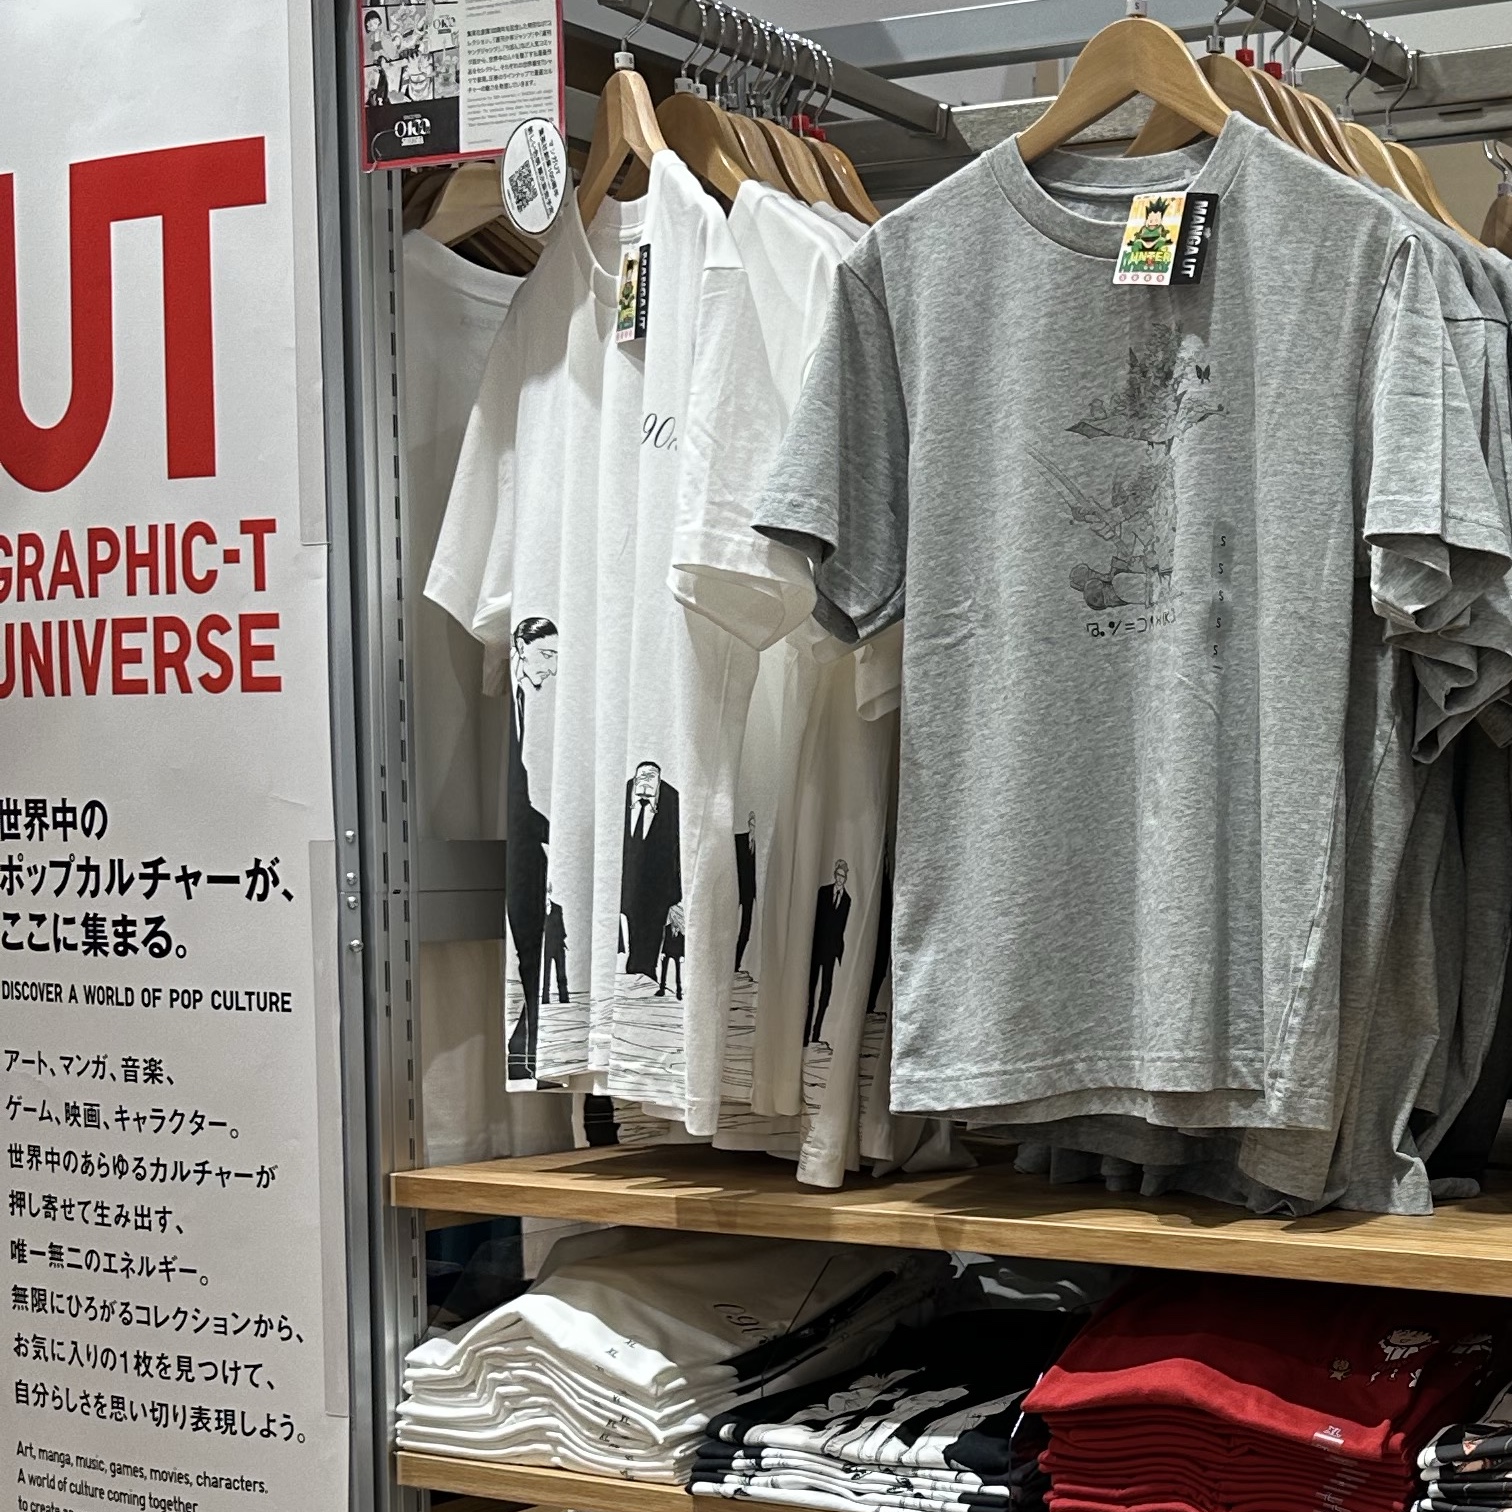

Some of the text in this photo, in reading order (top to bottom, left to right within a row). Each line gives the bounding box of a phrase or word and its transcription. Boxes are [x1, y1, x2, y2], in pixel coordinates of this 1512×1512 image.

[1180, 200, 1209, 278] MANGA UT
[0, 136, 266, 493] UT
[0, 797, 108, 842] 世界中の
[0, 853, 294, 902] ポップカルチャーが、
[1, 912, 187, 959] ここに集まる。
[1, 980, 293, 1013] DISCOVER A WORLD OF POP CULTURE
[7, 1143, 279, 1189] 世界中のあらゆるカルチャーが
[8, 1189, 184, 1234] 押し寄せて生み出す、
[11, 1284, 304, 1343] 無限にひろがるコレクションから、
[14, 1379, 306, 1443] 自分らしさを思い切り表現しよう。
[16, 1440, 269, 1494] Art, manga, music, games, movies, characters.
[27, 1472, 55, 1490] world
[69, 1480, 105, 1500] culture
[107, 1489, 146, 1511] coming
